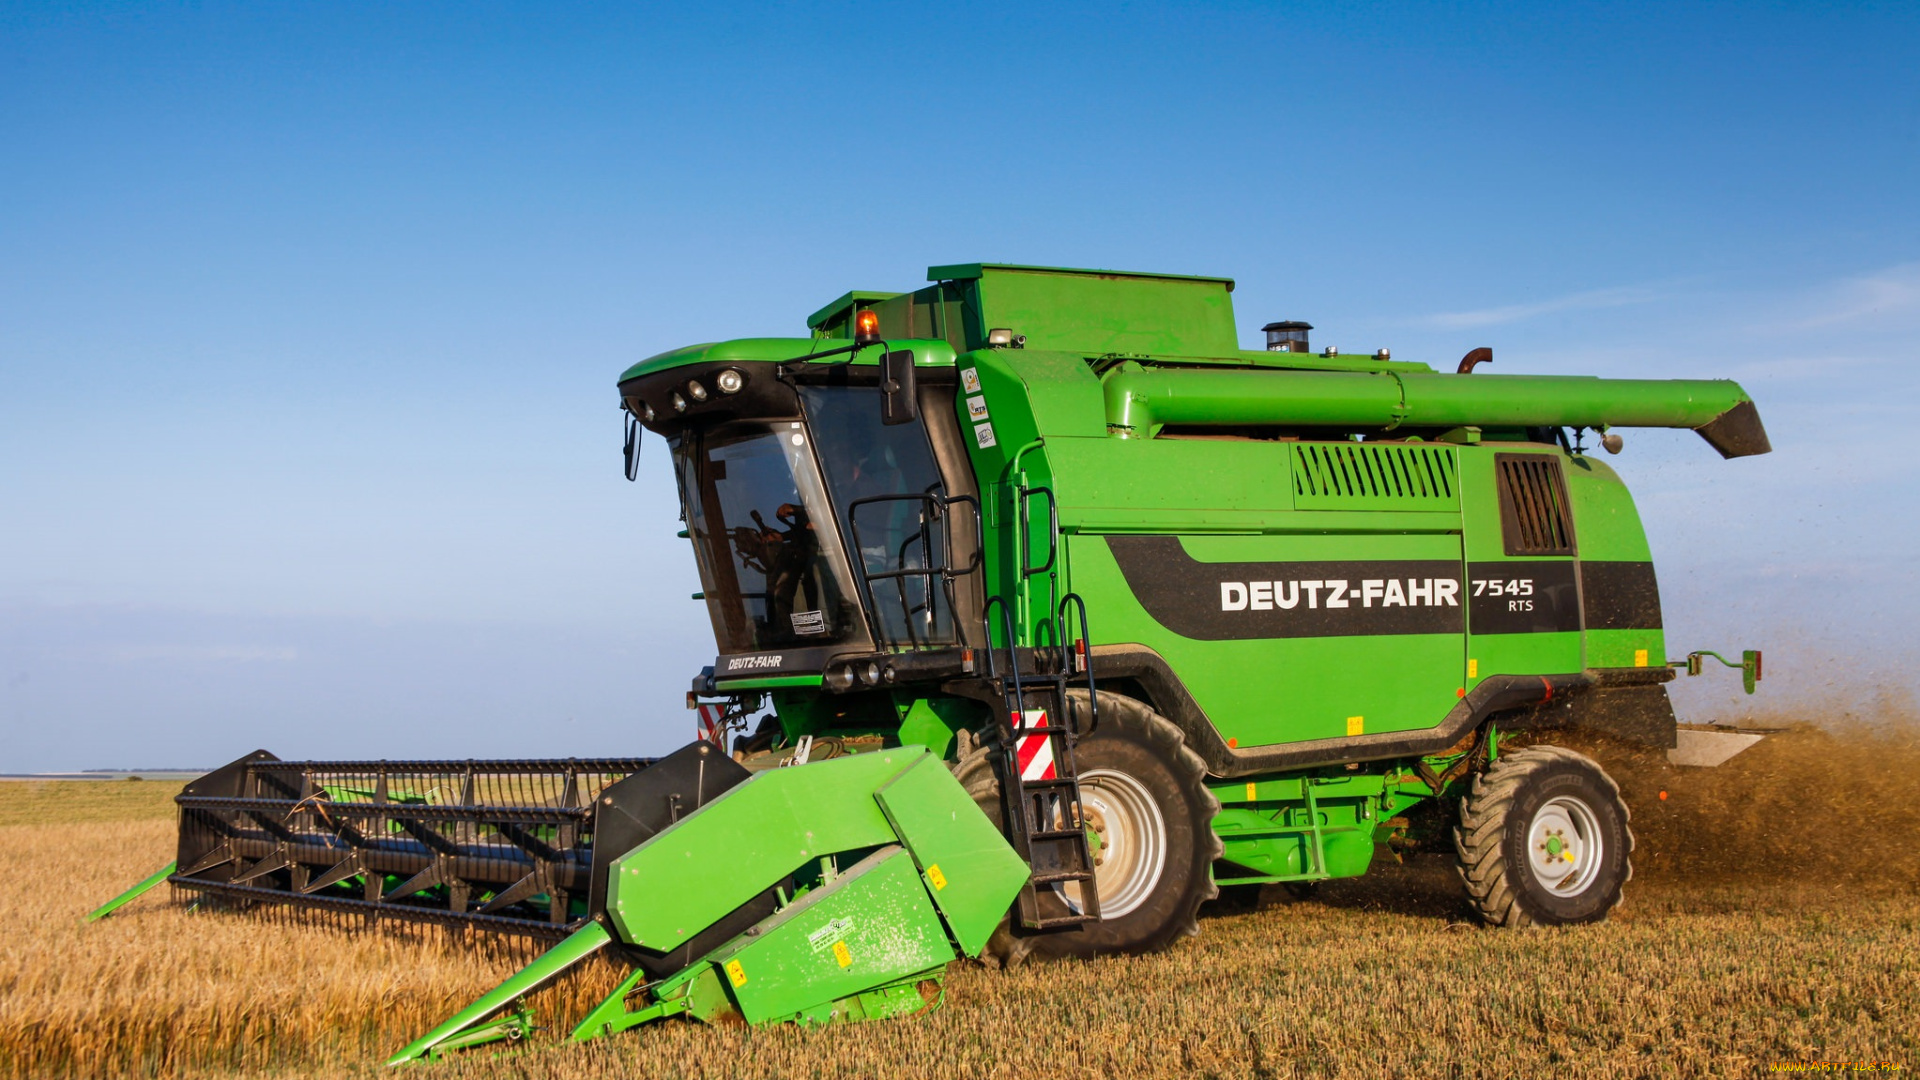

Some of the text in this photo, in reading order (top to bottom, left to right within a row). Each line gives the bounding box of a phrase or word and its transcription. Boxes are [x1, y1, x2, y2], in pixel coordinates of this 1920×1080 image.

[1220, 579, 1459, 611] DEUTZ-FAHR
[1472, 579, 1534, 597] 7545
[1508, 600, 1534, 612] RTS
[728, 655, 782, 670] DEUTZ-FAHR
